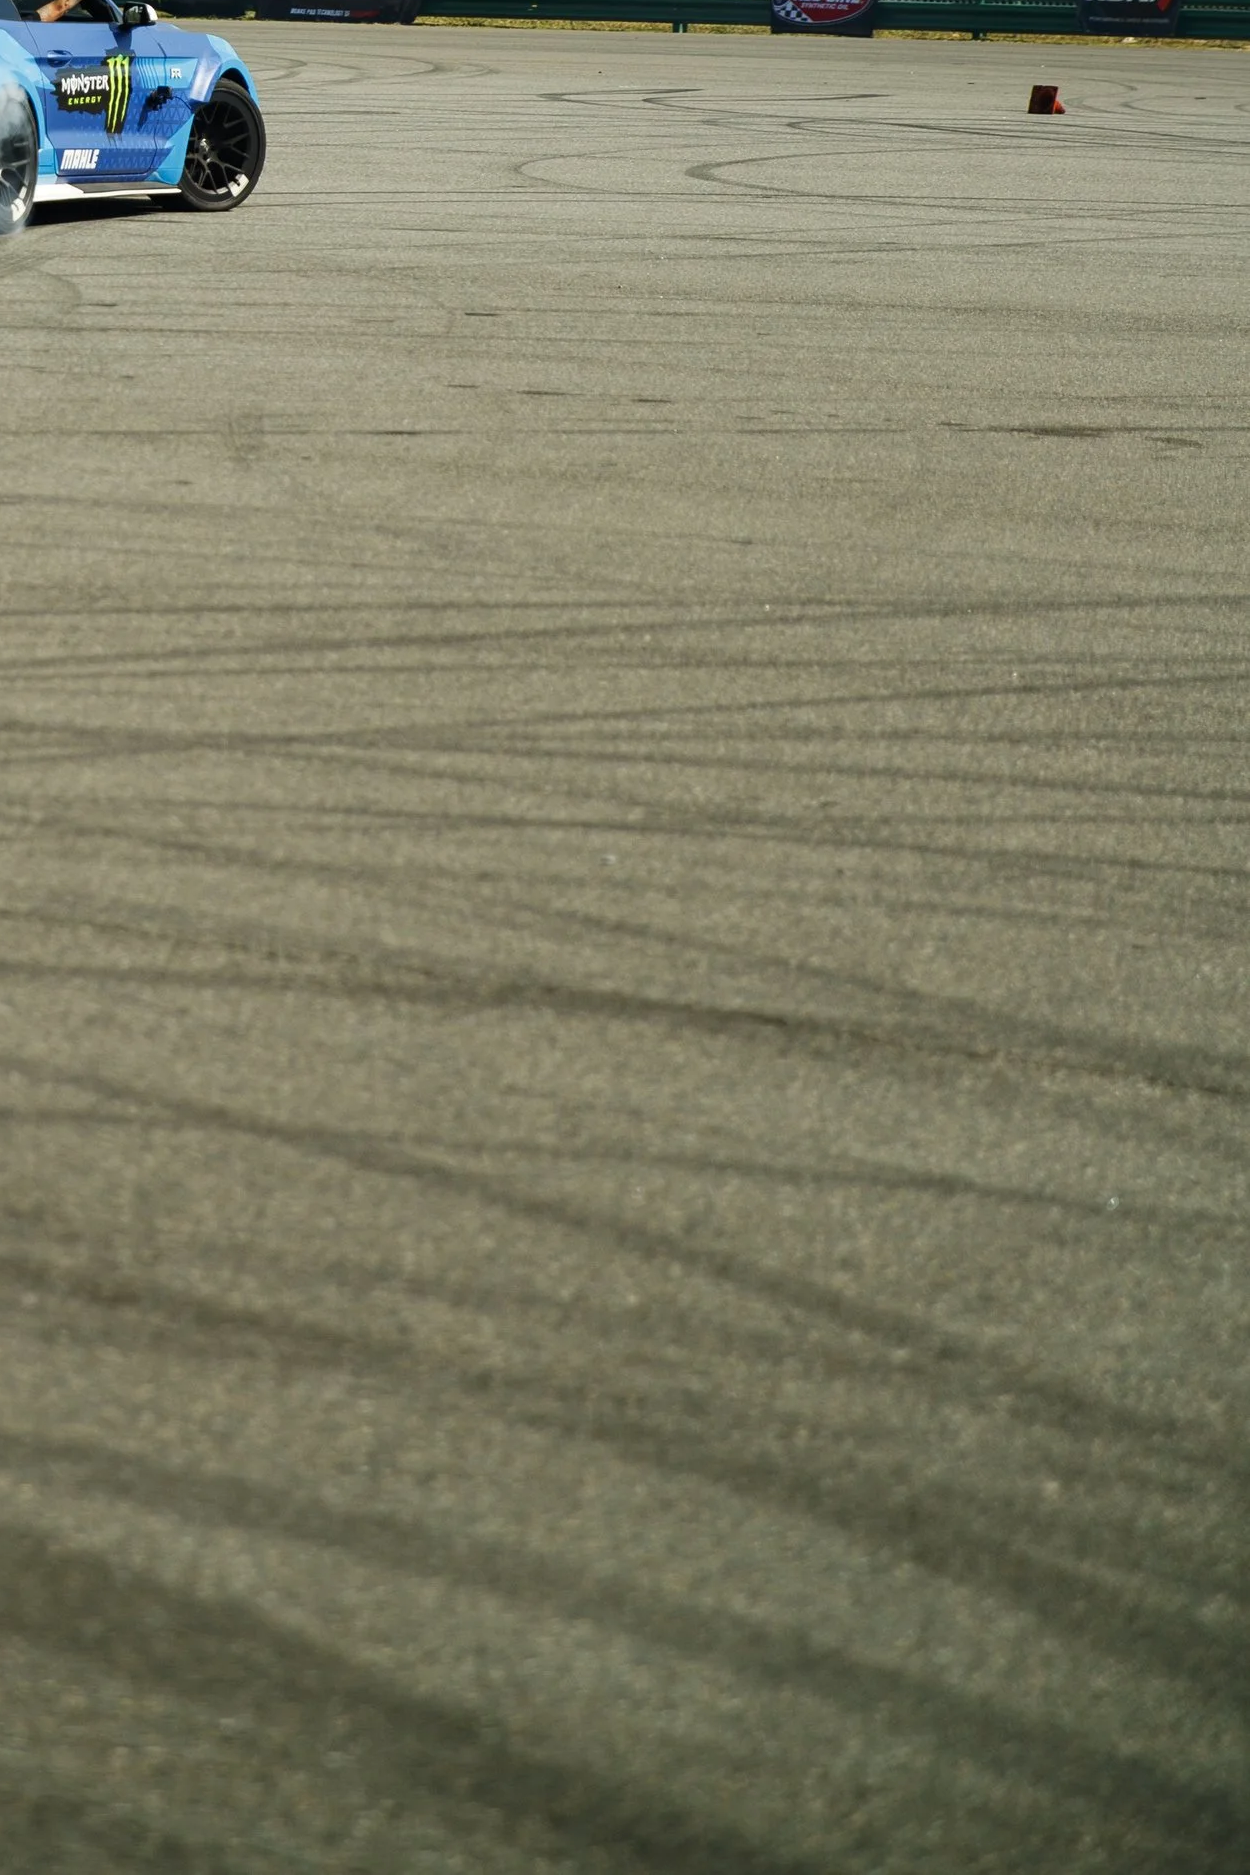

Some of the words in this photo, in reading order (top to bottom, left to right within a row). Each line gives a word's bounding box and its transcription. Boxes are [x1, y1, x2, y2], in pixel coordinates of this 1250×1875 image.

[61, 74, 110, 95] MONSTER
[68, 96, 102, 105] ENERGY
[60, 149, 100, 170] MAHLE
